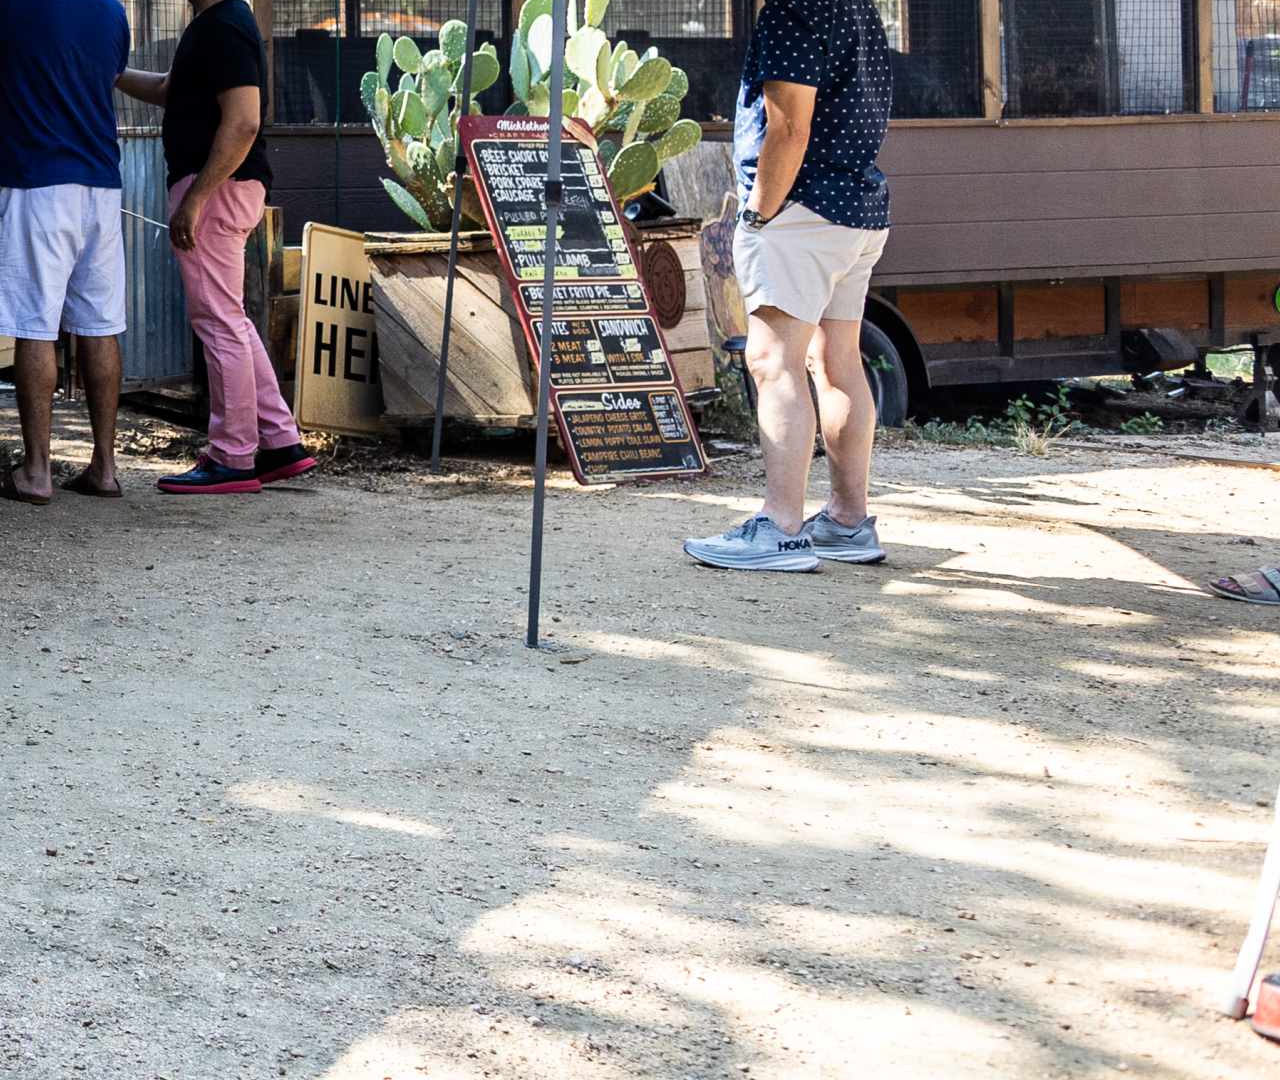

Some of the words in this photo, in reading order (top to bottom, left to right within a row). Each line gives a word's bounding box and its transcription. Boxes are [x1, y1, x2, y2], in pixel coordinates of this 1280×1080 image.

[481, 149, 507, 163] BEEF
[508, 150, 538, 163] SHORT
[485, 163, 525, 176] BRISKET
[490, 176, 515, 189] PORK
[515, 176, 544, 189] SPARE
[494, 189, 536, 202] SAUSAGE
[558, 254, 592, 267] LAMB
[314, 273, 375, 315] LINE
[567, 286, 594, 299] FRITO
[594, 286, 610, 298] PIE
[598, 320, 649, 336] SANDWICH
[558, 341, 582, 352] MEAT
[561, 353, 586, 364] MEAT
[601, 392, 642, 411] Sides
[632, 422, 653, 433] SALAD
[777, 538, 811, 552] HOKA
